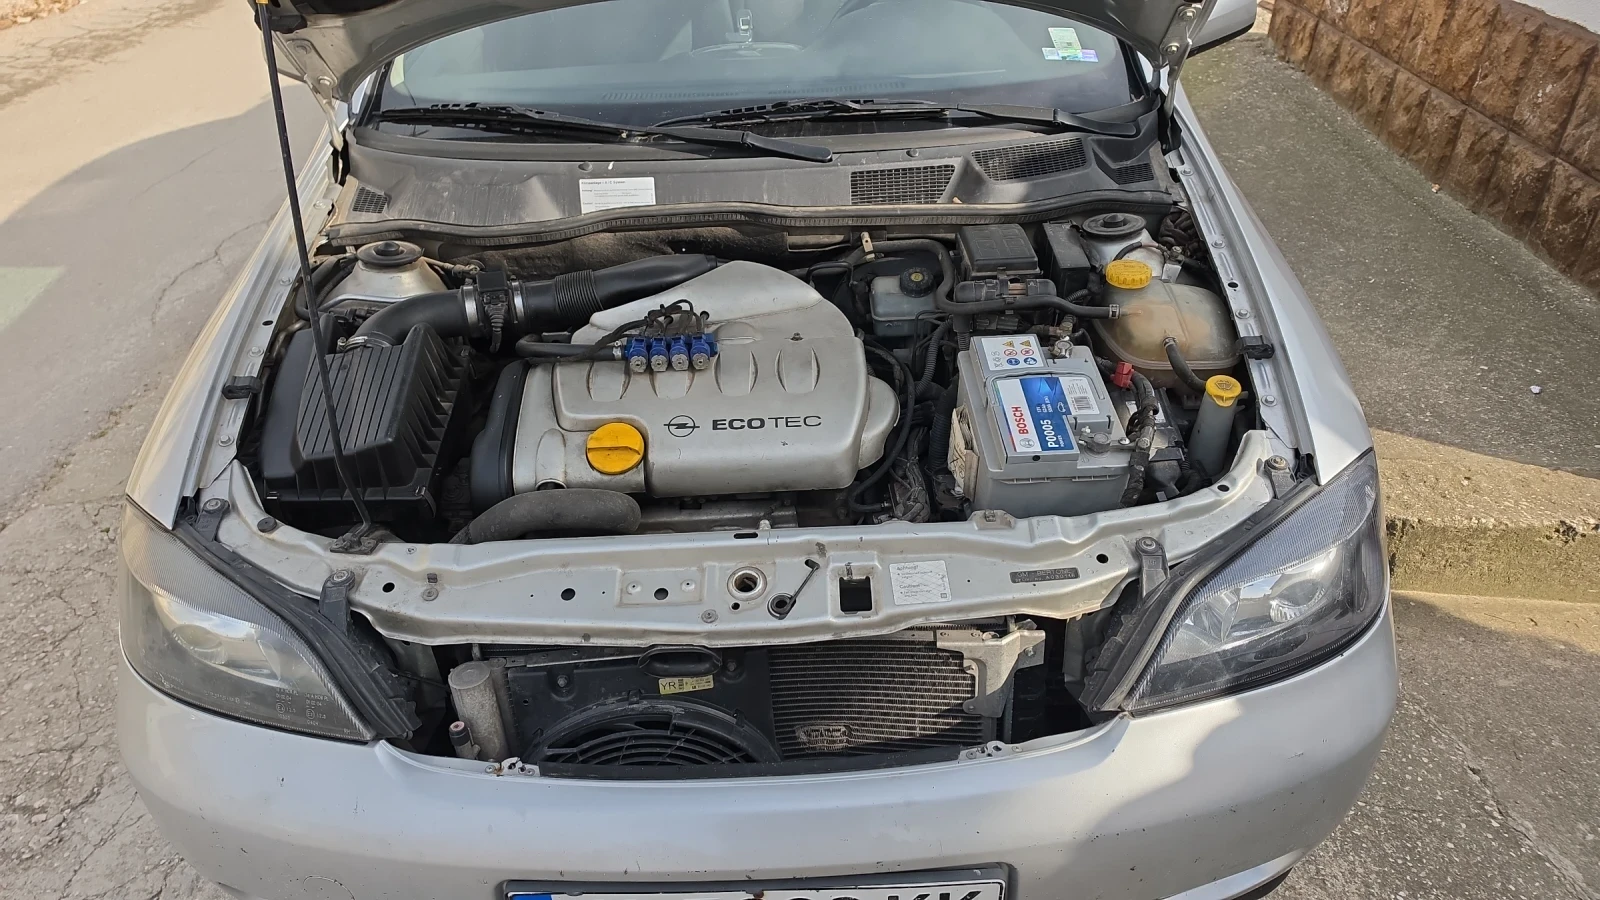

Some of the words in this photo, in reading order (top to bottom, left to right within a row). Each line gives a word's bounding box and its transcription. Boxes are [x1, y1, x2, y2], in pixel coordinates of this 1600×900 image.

[712, 415, 822, 430] ECOTEC
[1011, 406, 1029, 435] BOSCH
[1040, 419, 1060, 448] P0005
[660, 681, 677, 691] YR
